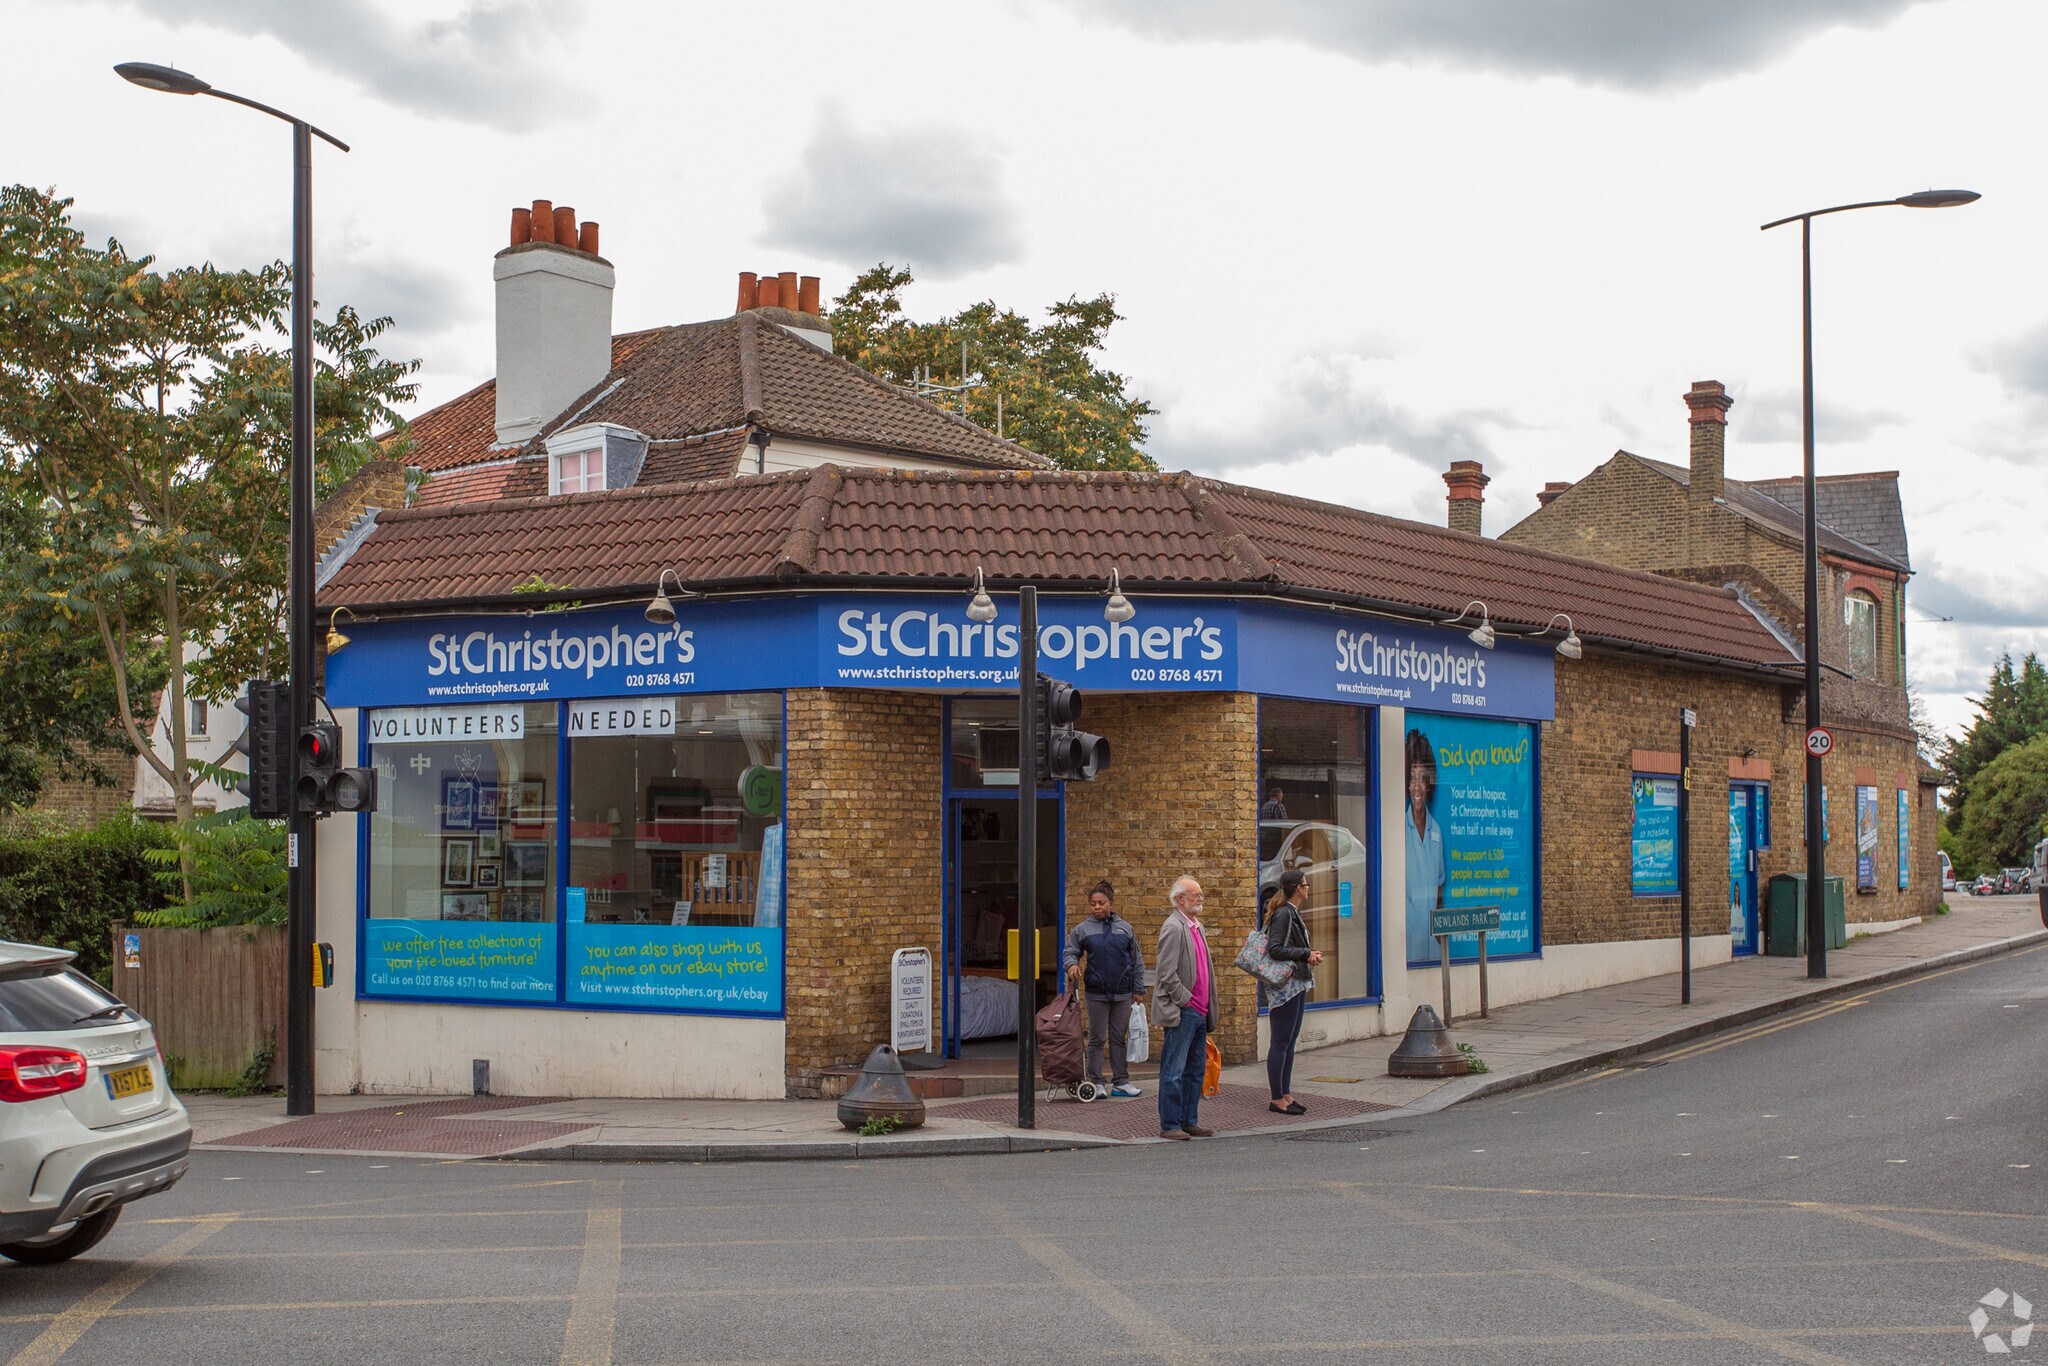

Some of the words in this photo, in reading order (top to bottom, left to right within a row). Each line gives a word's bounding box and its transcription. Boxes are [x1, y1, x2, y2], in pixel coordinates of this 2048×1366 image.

[838, 610, 1222, 671] StChrisopher's
[428, 622, 695, 679] StChristopher's
[1336, 629, 1486, 692] StChristopher's
[626, 675, 644, 687] 020
[646, 673, 670, 686] 8768
[672, 672, 695, 685] 4571
[838, 665, 1020, 683] www.stchristophers.org.uk
[1131, 669, 1155, 681] 020
[1159, 669, 1191, 681] 8768
[1194, 669, 1222, 682] 4571
[428, 679, 549, 696] www.stchristophers.org.uk
[1336, 682, 1411, 701] www.stchristophers.org.uk
[1452, 693, 1461, 704] 020
[1462, 694, 1474, 706] 8768
[1475, 695, 1486, 707] 4571
[372, 714, 520, 737] VOLUNTEERS
[571, 709, 672, 731] NEEDED
[1810, 736, 1829, 748] 20
[1440, 743, 1464, 767] Did
[1465, 749, 1488, 776] you
[1490, 738, 1528, 765] know?
[1450, 786, 1466, 799] Your
[1466, 785, 1482, 800] local
[1451, 804, 1458, 817] St
[1501, 806, 1507, 818] is
[1508, 805, 1519, 819] less
[1450, 822, 1466, 835] than
[1466, 822, 1479, 835] half
[1480, 827, 1484, 835] a
[1485, 823, 1498, 836] mile
[1499, 827, 1514, 840] away
[1451, 848, 1461, 860] We
[1463, 850, 1487, 865] support
[1451, 866, 1472, 882] people
[1474, 869, 1492, 879] across
[1493, 865, 1510, 879] south
[1451, 886, 1464, 898] east
[1466, 885, 1488, 898] London
[1489, 887, 1505, 900] every
[1507, 887, 1519, 900] year
[1434, 914, 1469, 928] NEWLANDS
[1472, 913, 1488, 925] PARK
[1512, 912, 1519, 921] us
[1520, 910, 1527, 921] at
[405, 935, 436, 955] offer
[439, 934, 464, 957] free
[467, 934, 525, 949] collection
[529, 933, 543, 951] of
[613, 944, 637, 957] can
[640, 941, 669, 957] also
[672, 941, 705, 962] shop
[707, 939, 743, 955] with
[746, 941, 762, 954] us
[386, 957, 413, 973] your
[416, 952, 476, 972] pre-loved
[479, 950, 538, 970] furniture!
[581, 960, 636, 982] anytime
[639, 963, 656, 974] on
[660, 963, 684, 975] our
[687, 958, 723, 979] eBay
[726, 957, 769, 974] store!
[371, 973, 388, 984] Call
[390, 975, 400, 985] us
[402, 977, 413, 986] on
[415, 975, 431, 986] 020
[433, 976, 454, 988] 8768
[456, 977, 476, 988] 4571
[478, 979, 488, 989] to
[490, 977, 508, 990] find
[510, 980, 527, 990] out
[529, 981, 554, 991] more
[901, 976, 924, 986] VOLUNTEERS
[580, 981, 602, 993] Visit
[605, 982, 768, 1003] www.stchristophers.org.uk/ebay
[903, 987, 921, 996] REQUIRED
[905, 1002, 918, 1011] QUALITY
